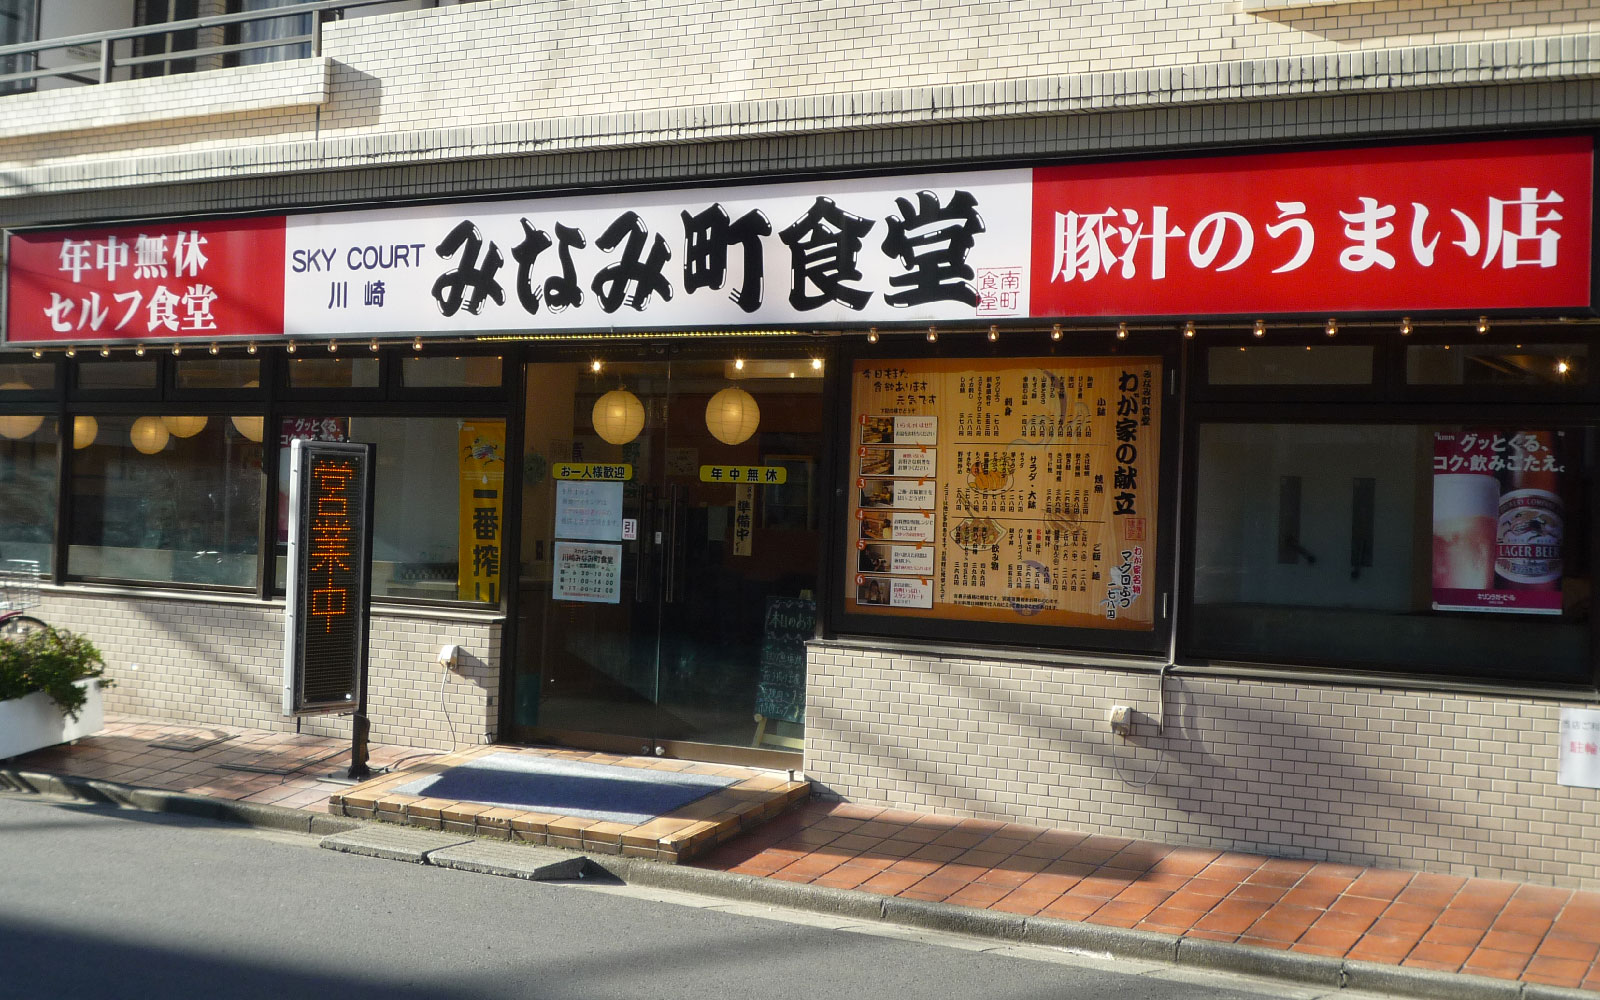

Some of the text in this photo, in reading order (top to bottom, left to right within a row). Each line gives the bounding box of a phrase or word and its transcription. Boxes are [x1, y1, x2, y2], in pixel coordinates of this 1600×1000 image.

[1051, 187, 1564, 283] 豚汁のうまい店
[59, 230, 208, 282] 年中無休
[292, 244, 425, 272] SKY COURT
[430, 189, 986, 317] みなみ町食堂
[328, 279, 385, 309] 川崎
[44, 284, 218, 332] セルフ食堂
[863, 368, 908, 379] 今日もまた
[874, 381, 928, 393] 食欲あります
[896, 394, 936, 405] 元気です
[1004, 397, 1013, 416] 刺身
[1114, 371, 1140, 516] わが家の献立
[1461, 433, 1550, 452] グッとくる、
[561, 466, 625, 480] お一人様歓迎
[710, 468, 778, 482] 年中無休
[1434, 455, 1565, 473] コク・飲みごたえ。
[1028, 456, 1038, 509] サラダ・大鉢
[312, 460, 352, 633] 営業中
[562, 554, 614, 564] 川崎みなみ町食堂
[991, 544, 1000, 571] 飲み物
[1500, 546, 1560, 558] LAGER BEER
[1118, 550, 1133, 608] マグロぶつ
[1132, 547, 1143, 594] わが家名物
